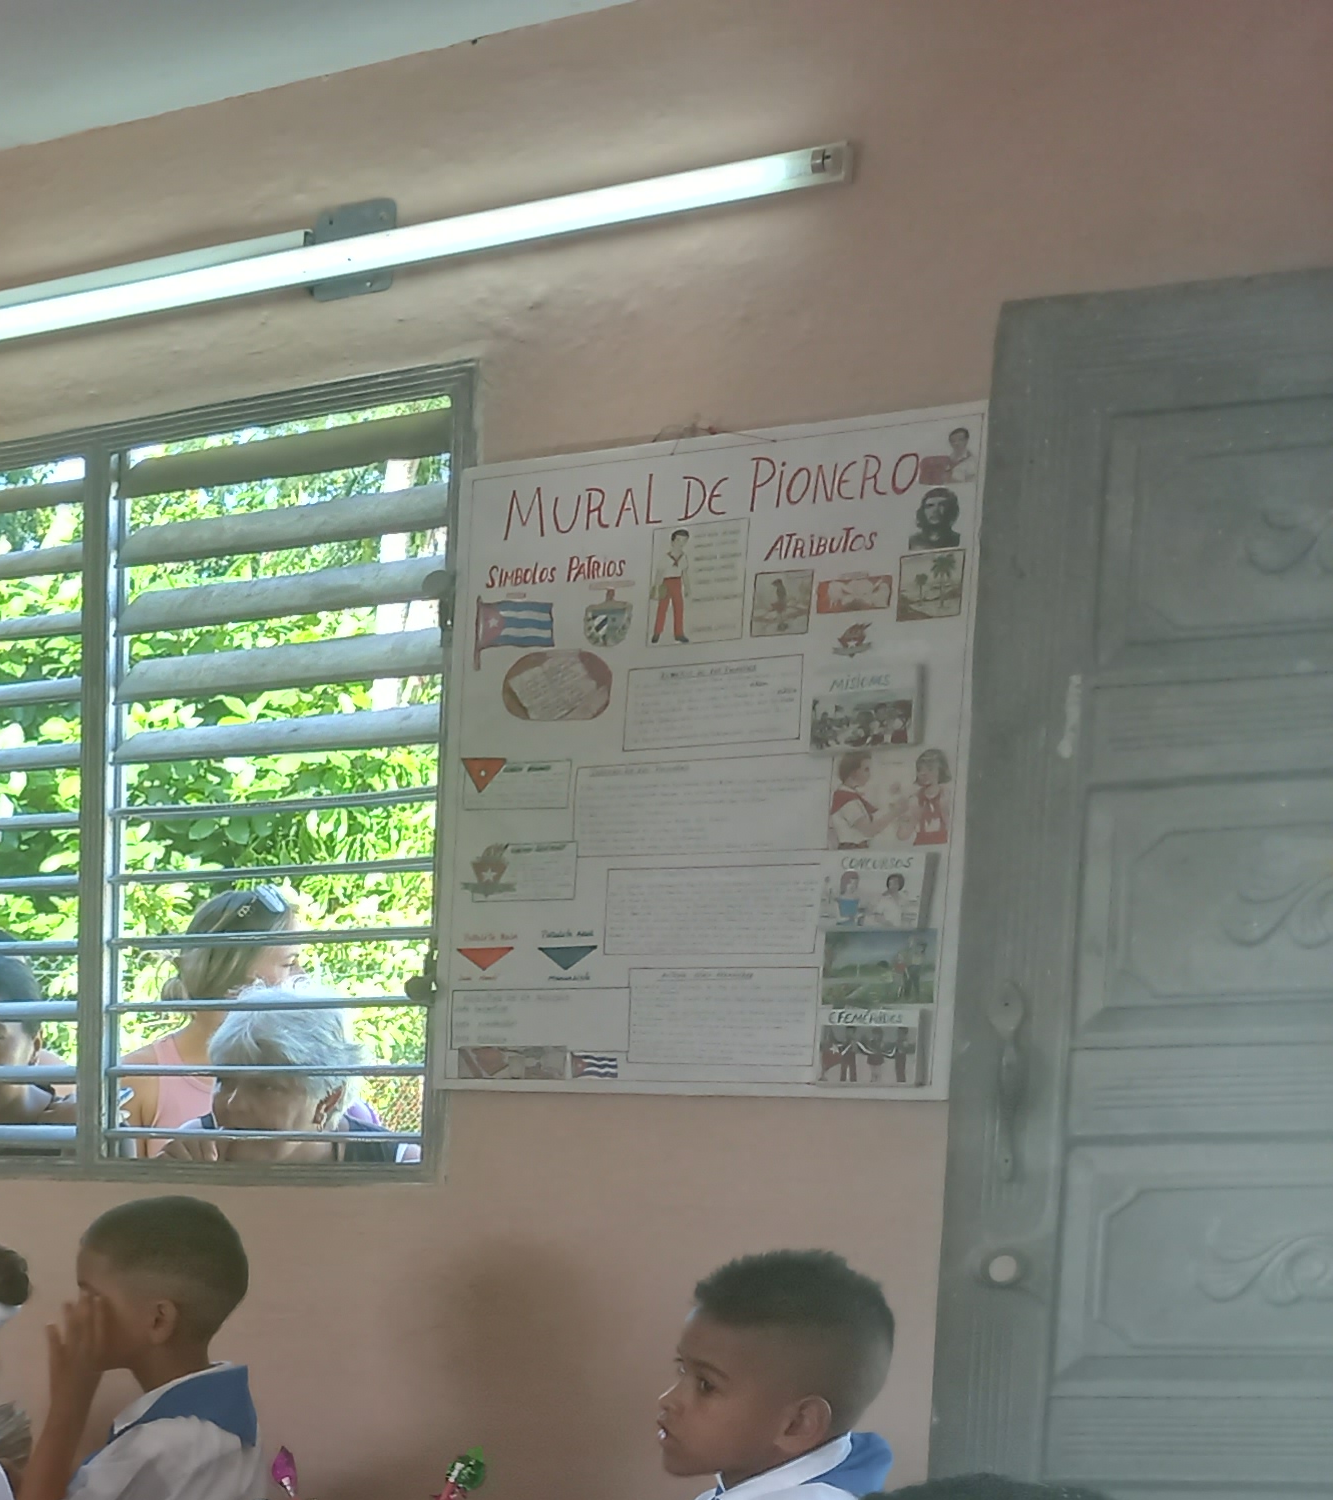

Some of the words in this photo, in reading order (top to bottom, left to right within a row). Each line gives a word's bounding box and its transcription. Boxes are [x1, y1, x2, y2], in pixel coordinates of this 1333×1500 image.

[503, 473, 663, 542] MURAL
[677, 475, 729, 522] DE
[486, 562, 556, 590] SIMBOLOS
[566, 554, 627, 583] PATRIOS
